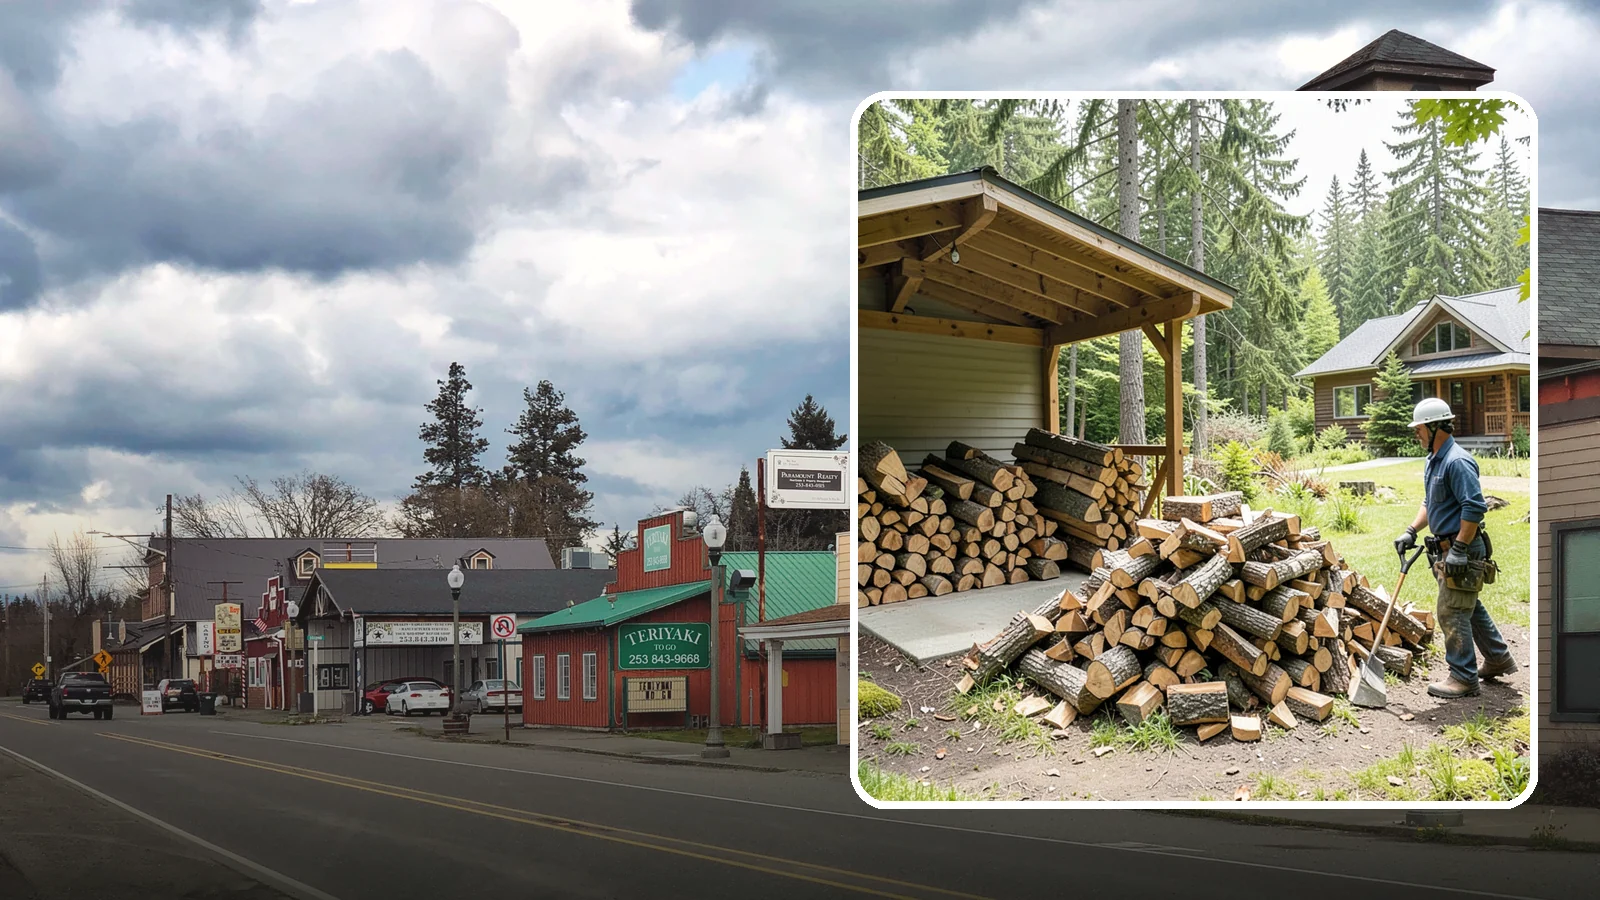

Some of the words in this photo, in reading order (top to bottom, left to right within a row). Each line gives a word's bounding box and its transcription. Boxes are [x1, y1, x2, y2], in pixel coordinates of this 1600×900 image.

[781, 471, 814, 479] PARAMOUNT
[817, 472, 839, 480] REALTY
[624, 627, 702, 646] TERIYAKI
[629, 654, 648, 664] 253
[651, 653, 700, 664] 843-9668
